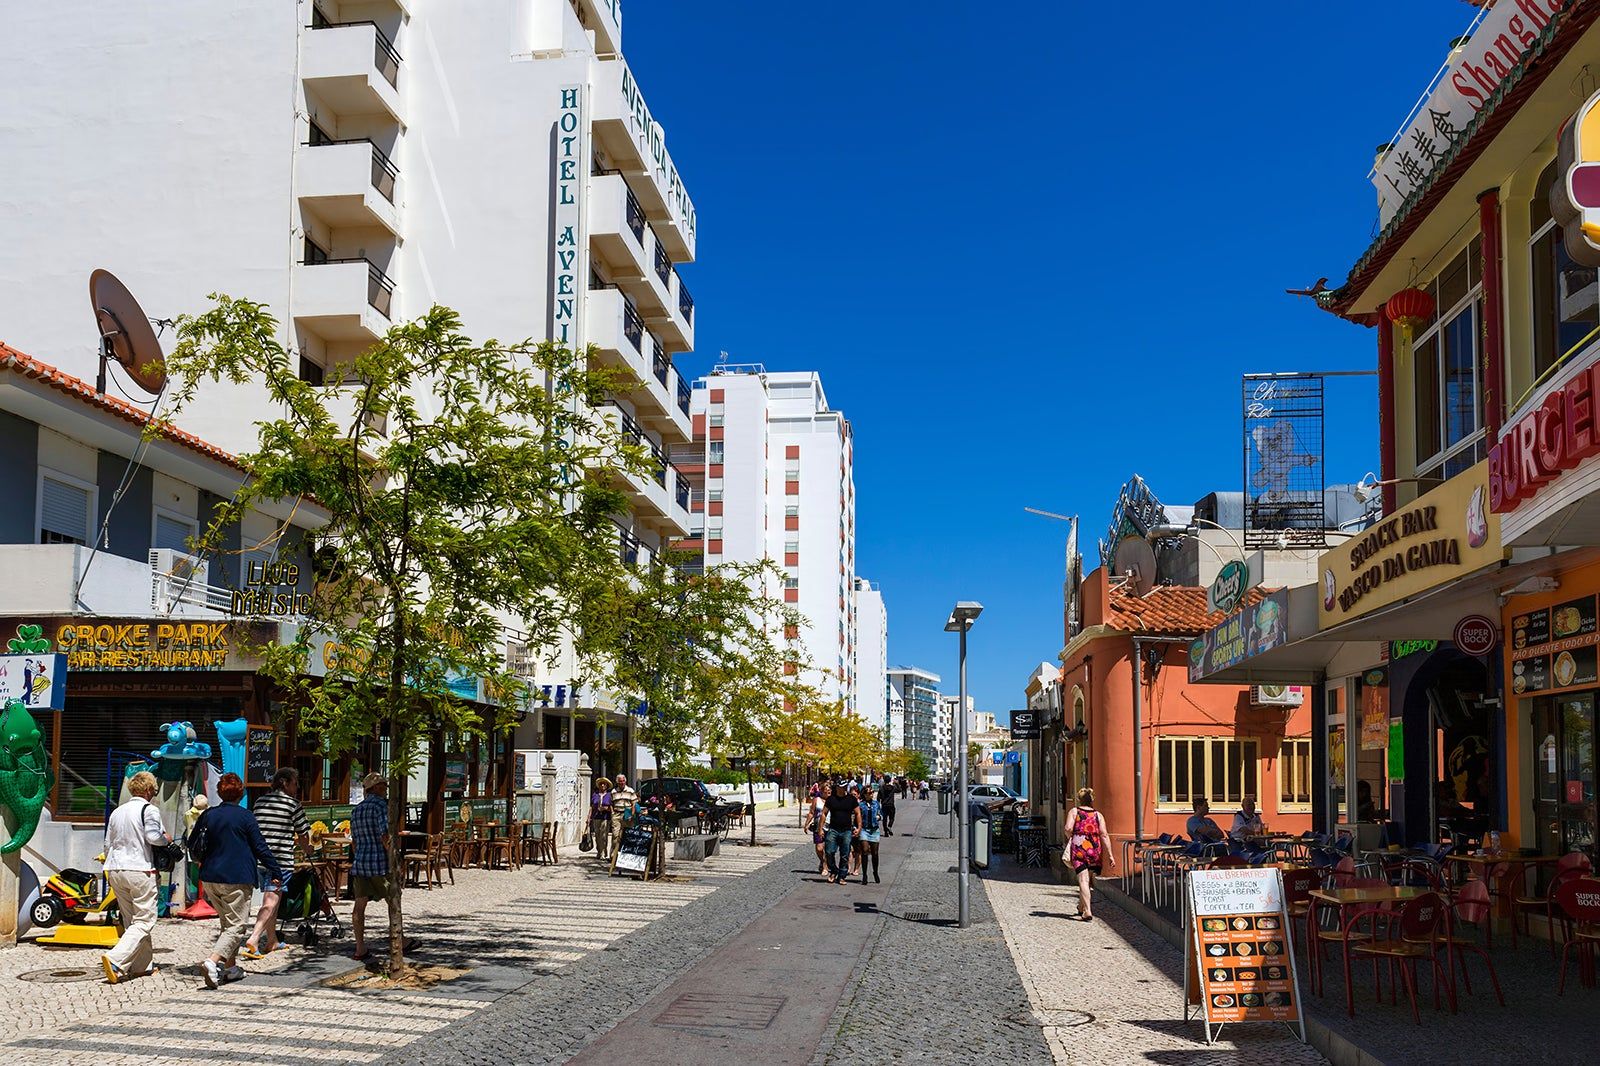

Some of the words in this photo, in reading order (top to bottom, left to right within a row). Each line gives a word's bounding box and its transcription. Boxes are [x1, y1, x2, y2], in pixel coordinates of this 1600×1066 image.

[560, 88, 578, 204] HOTEL
[622, 66, 668, 178] AVENIDA
[670, 166, 696, 239] PRAIA
[1350, 518, 1400, 571] SNACK
[1401, 506, 1437, 538] BAR
[1337, 565, 1381, 612] VASCO
[1382, 553, 1406, 582] DA
[1406, 538, 1461, 571] GAMA
[57, 624, 149, 647] CROKE
[157, 624, 228, 647] PARK
[1462, 628, 1489, 637] SUPER
[1464, 634, 1488, 644] BOCK
[1529, 642, 1560, 657] QUENTE
[1562, 636, 1583, 648] TODO
[1206, 872, 1223, 880] FULL
[1224, 870, 1269, 880] BREAKFAST
[1575, 892, 1600, 900] SUPER
[1577, 899, 1600, 907] BOCK
